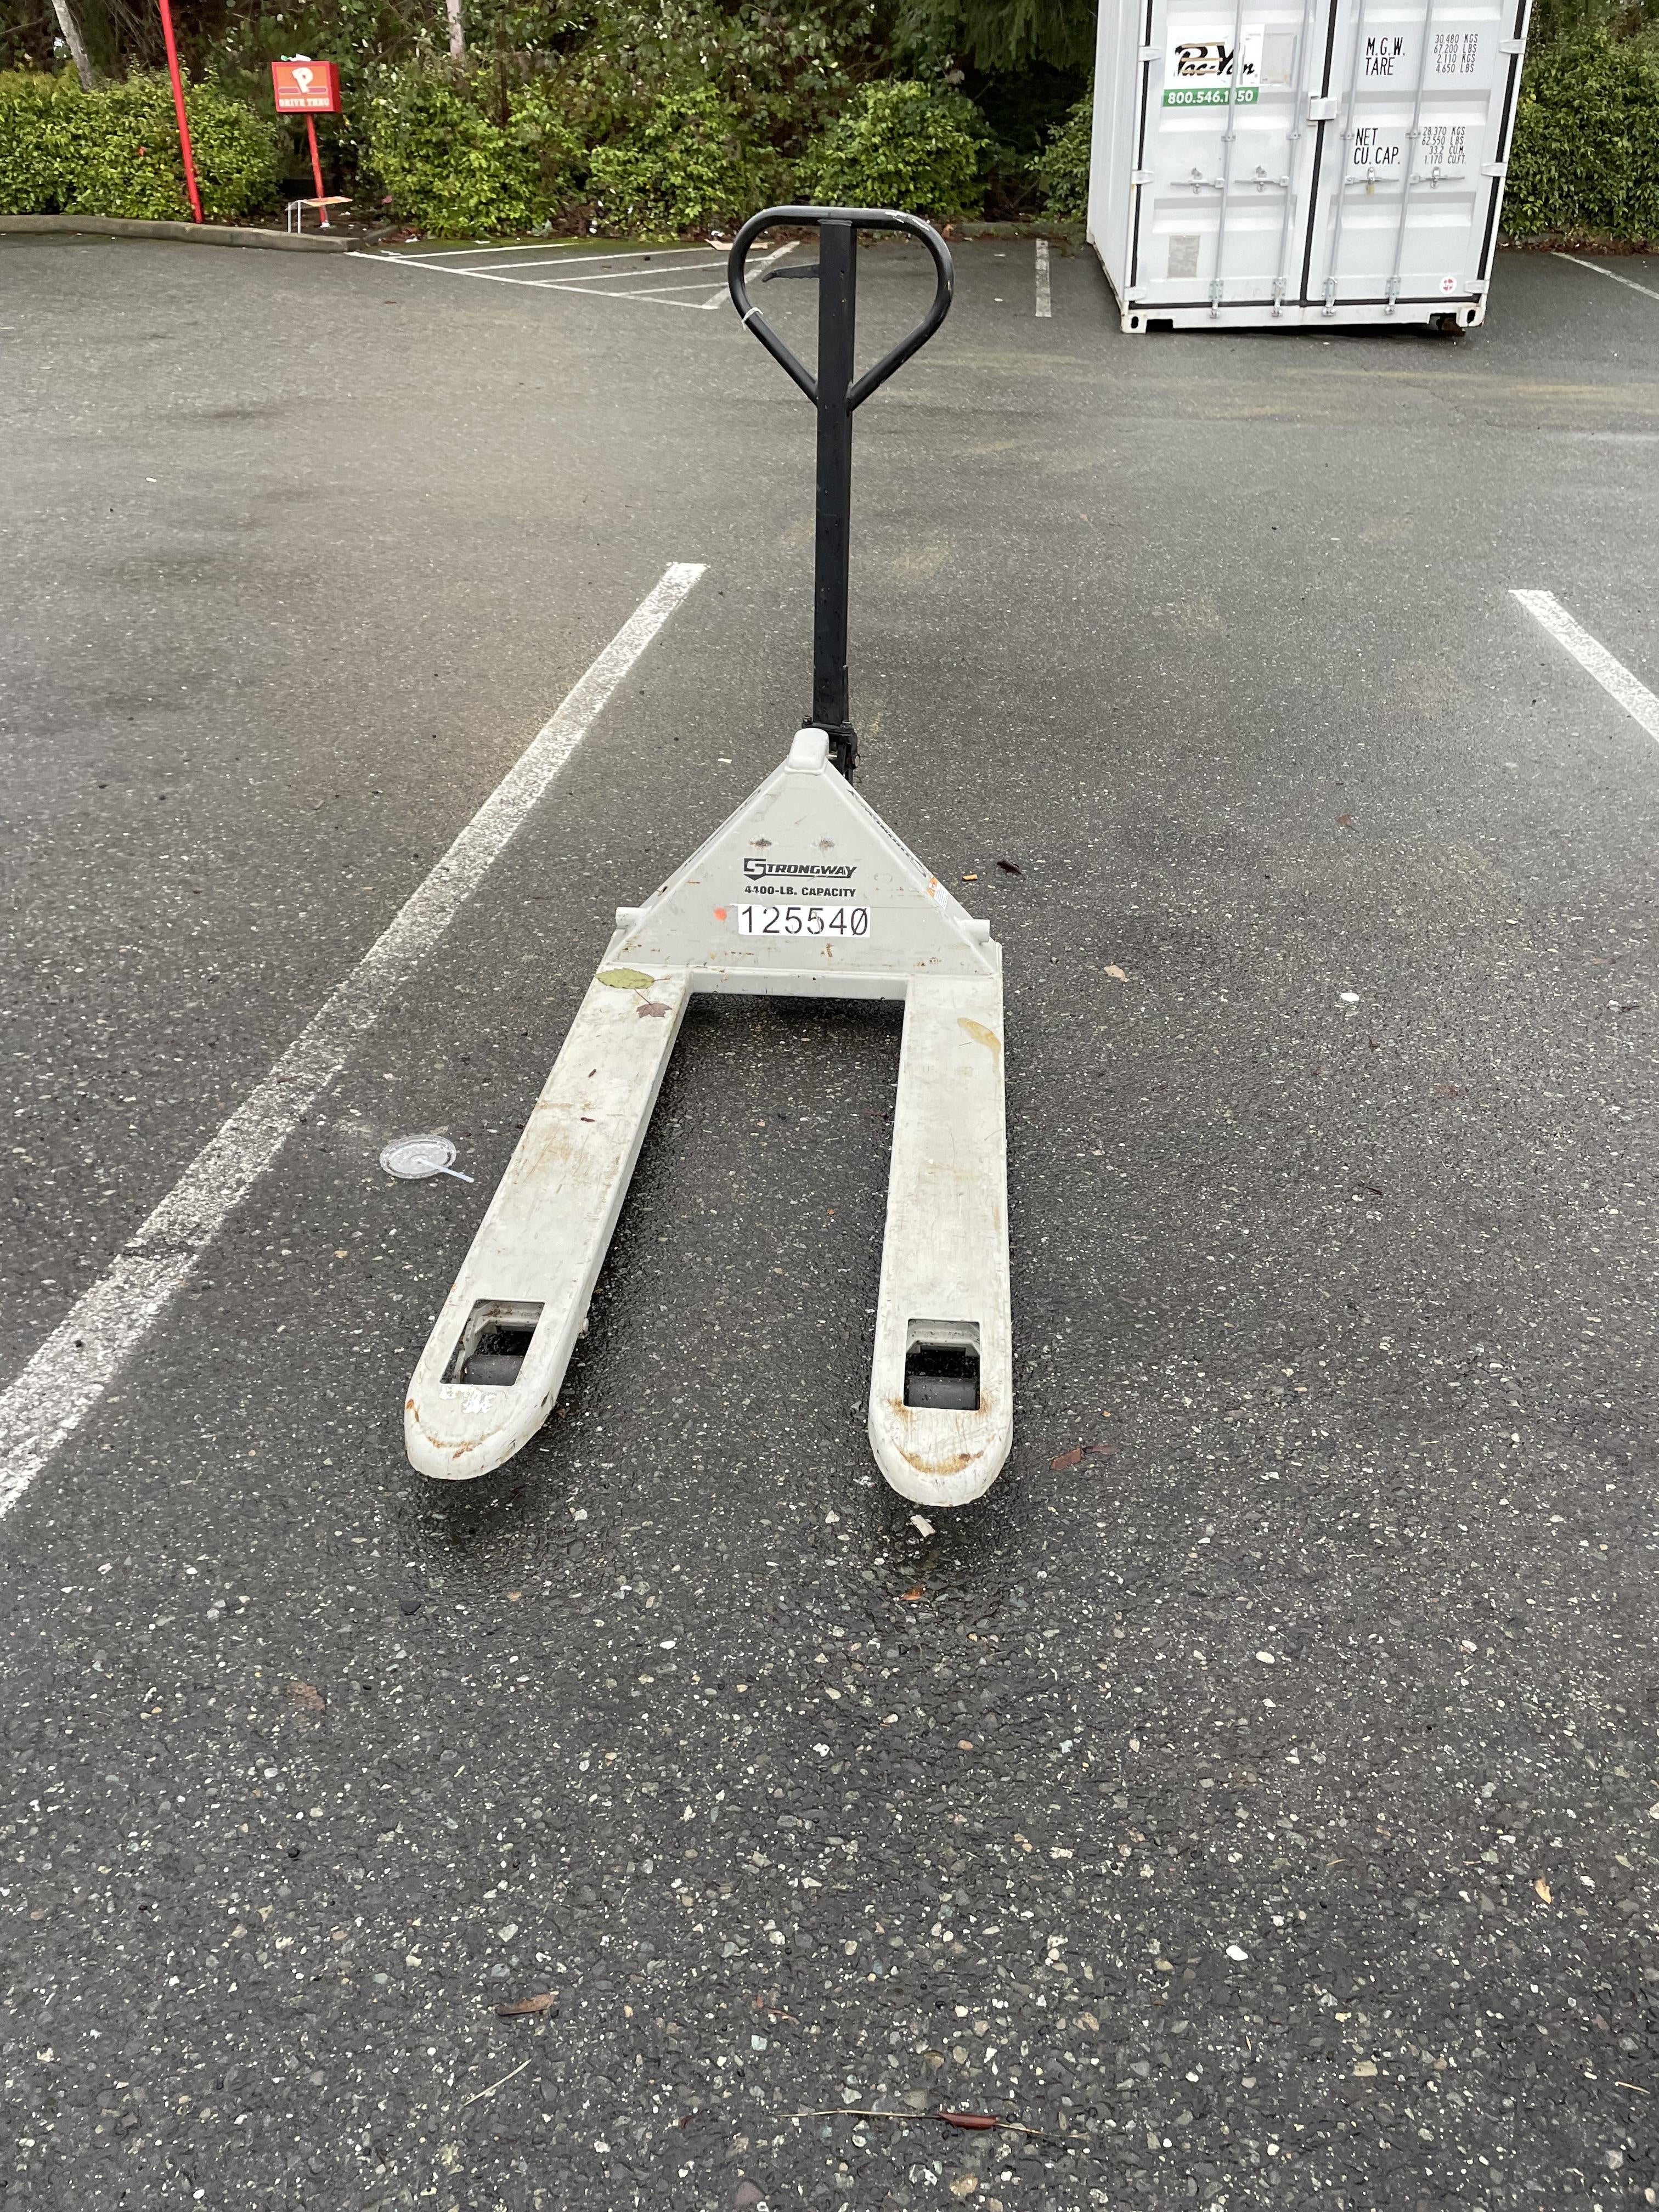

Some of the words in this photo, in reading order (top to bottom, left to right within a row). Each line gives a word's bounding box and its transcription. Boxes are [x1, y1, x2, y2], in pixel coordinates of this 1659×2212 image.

[1464, 33, 1478, 43] KGS
[1366, 37, 1405, 55] M.G.W.
[1463, 44, 1477, 53] LBS
[1462, 54, 1476, 63] KGS
[1365, 57, 1395, 75] TARE
[1460, 64, 1474, 73] LBS
[291, 67, 313, 93] P
[1167, 90, 1254, 104] 800.546.150
[279, 98, 305, 107] DRIVE
[307, 98, 329, 106] THRU
[1452, 126, 1465, 136] KGS
[1356, 128, 1378, 145] NET
[1450, 136, 1464, 145] LBS
[744, 858, 857, 880] STRONGWAY
[802, 887, 856, 897] CAPACITY
[742, 906, 868, 936] 125540
